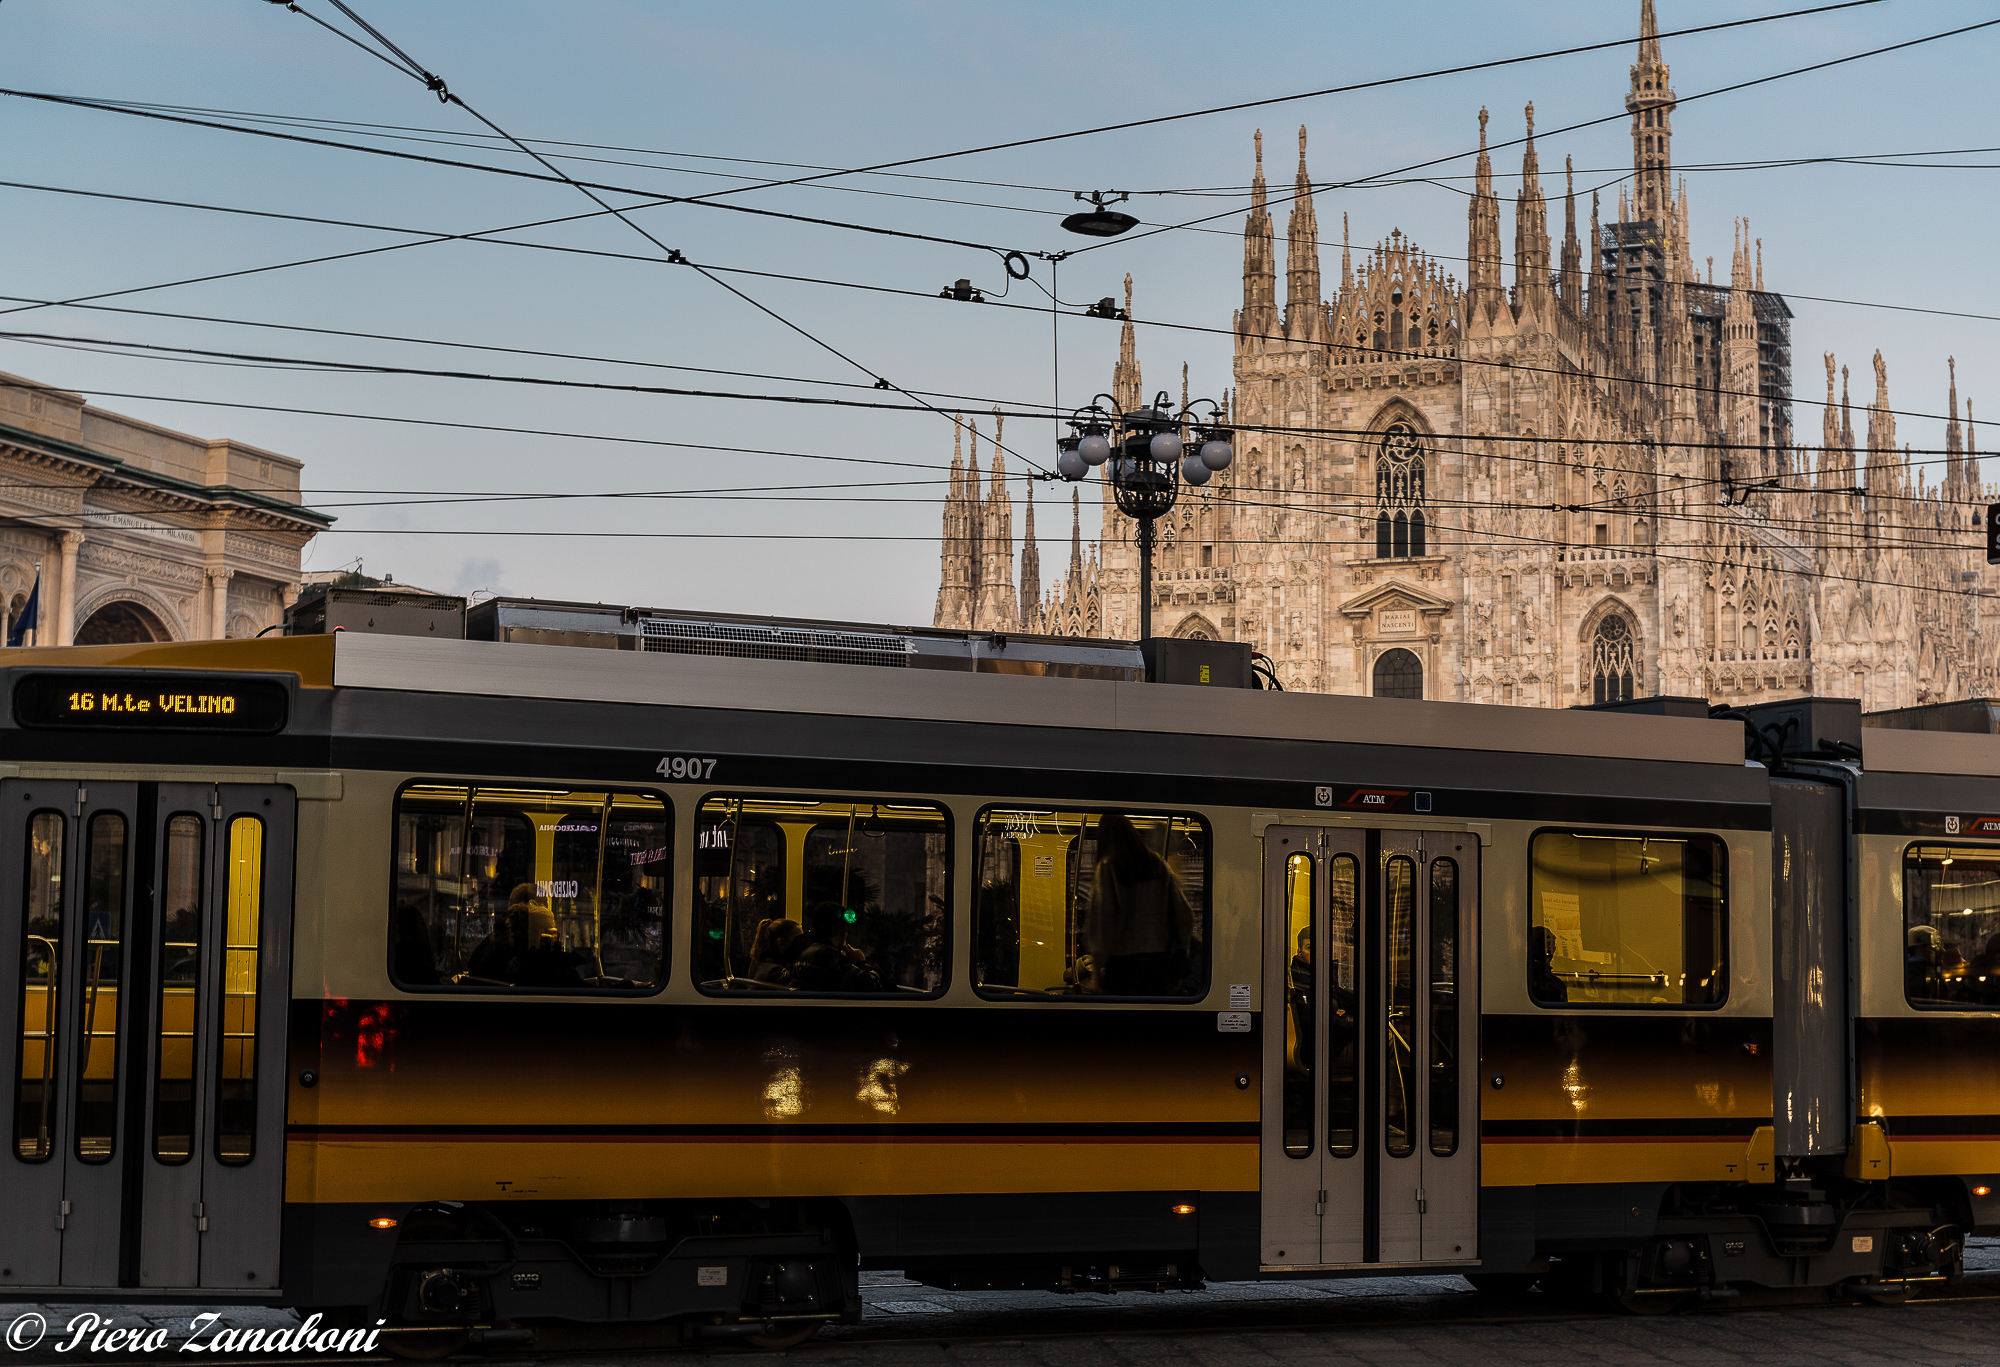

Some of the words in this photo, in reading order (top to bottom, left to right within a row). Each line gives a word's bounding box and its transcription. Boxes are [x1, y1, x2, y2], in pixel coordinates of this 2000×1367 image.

[166, 527, 196, 543] MILANESI
[1381, 621, 1414, 629] NASCENTI
[68, 692, 94, 711] 16
[101, 693, 151, 712] M.te
[159, 694, 235, 714] VELINO
[655, 757, 718, 779] 4907
[1362, 794, 1386, 805] ATM
